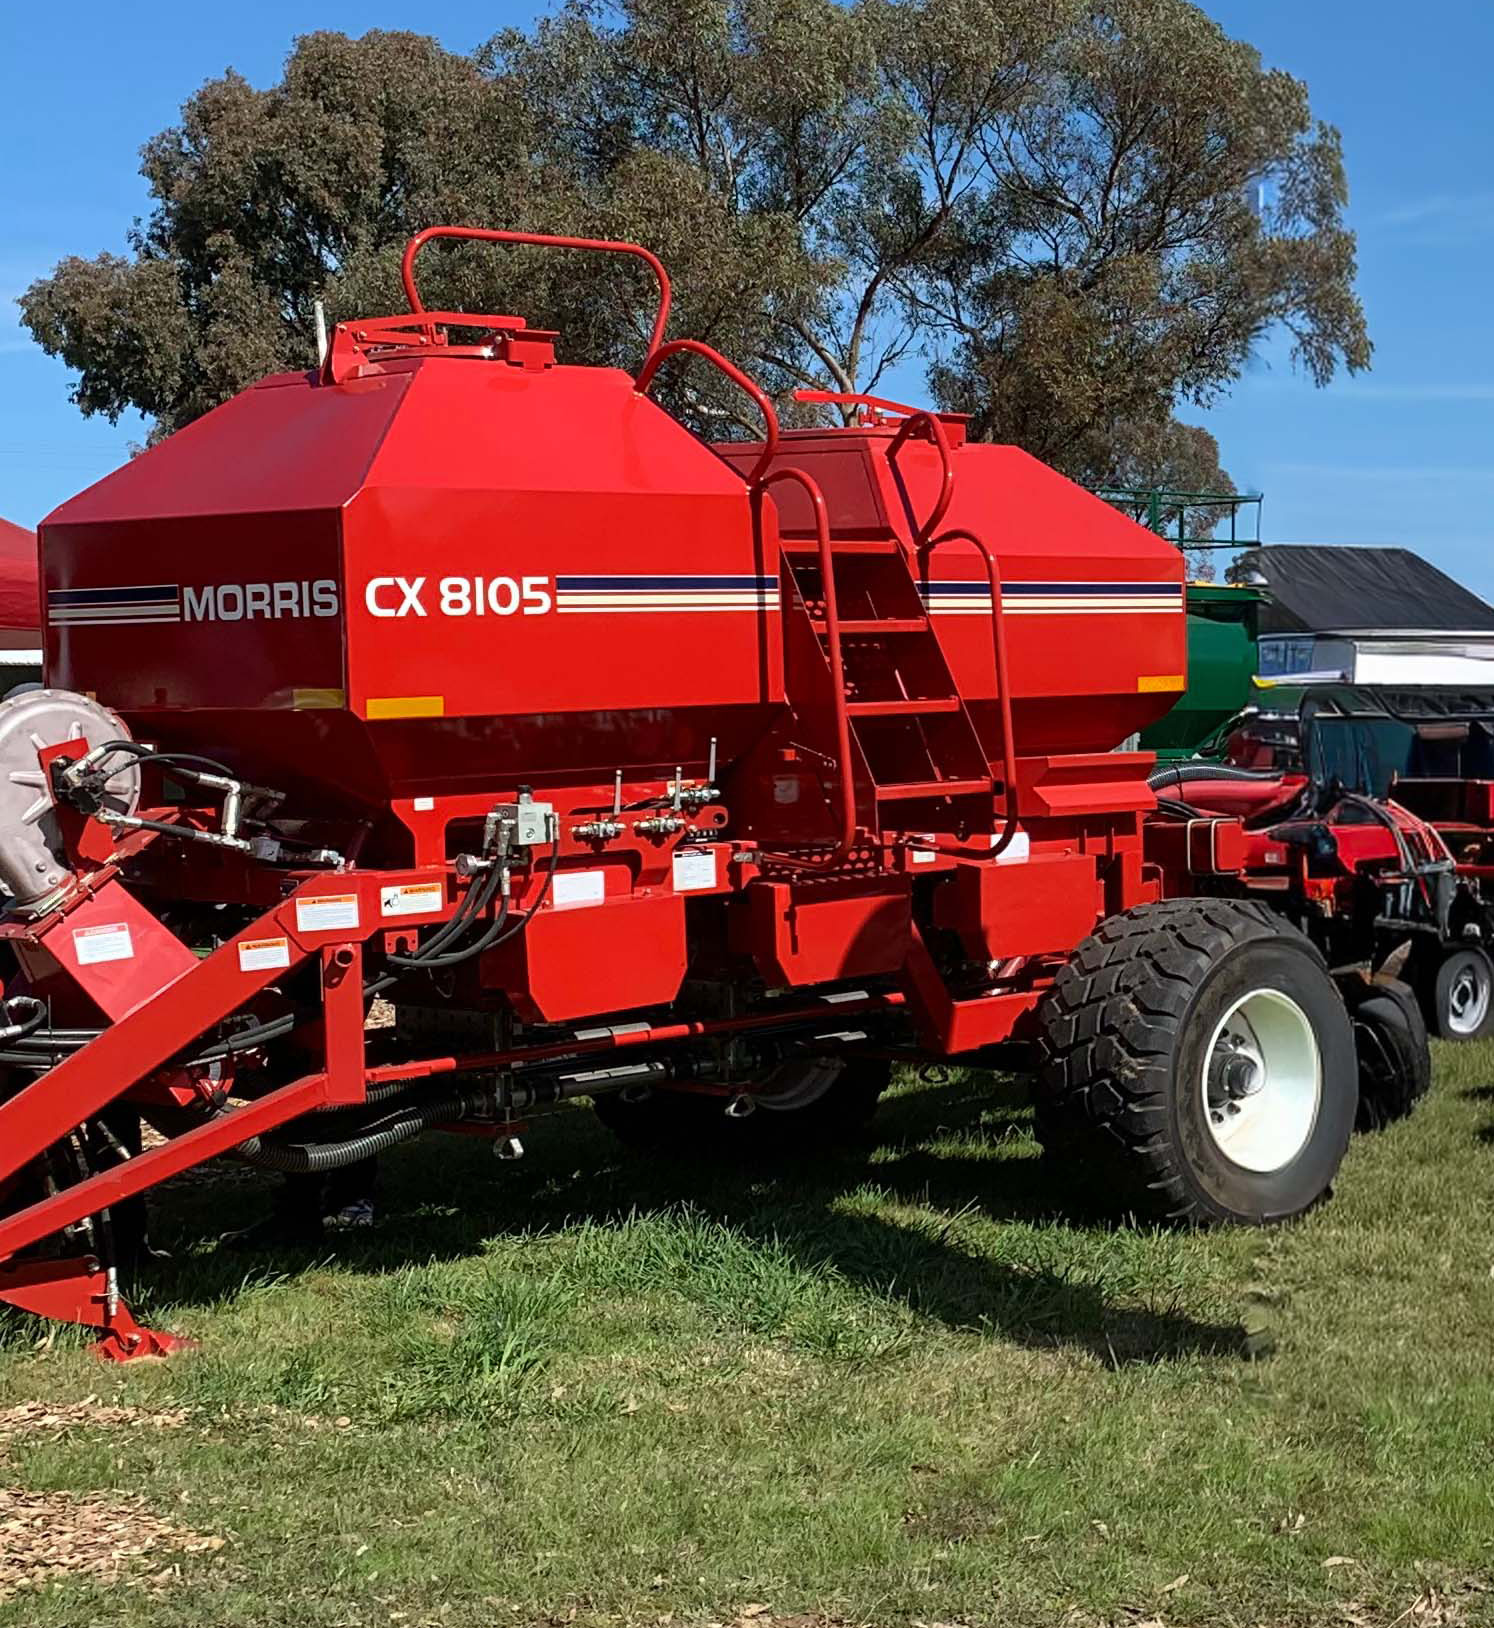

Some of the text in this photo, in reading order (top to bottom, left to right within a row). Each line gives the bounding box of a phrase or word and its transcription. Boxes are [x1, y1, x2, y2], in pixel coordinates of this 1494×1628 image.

[183, 580, 338, 622] MORRIS
[365, 576, 552, 617] CX 8105
